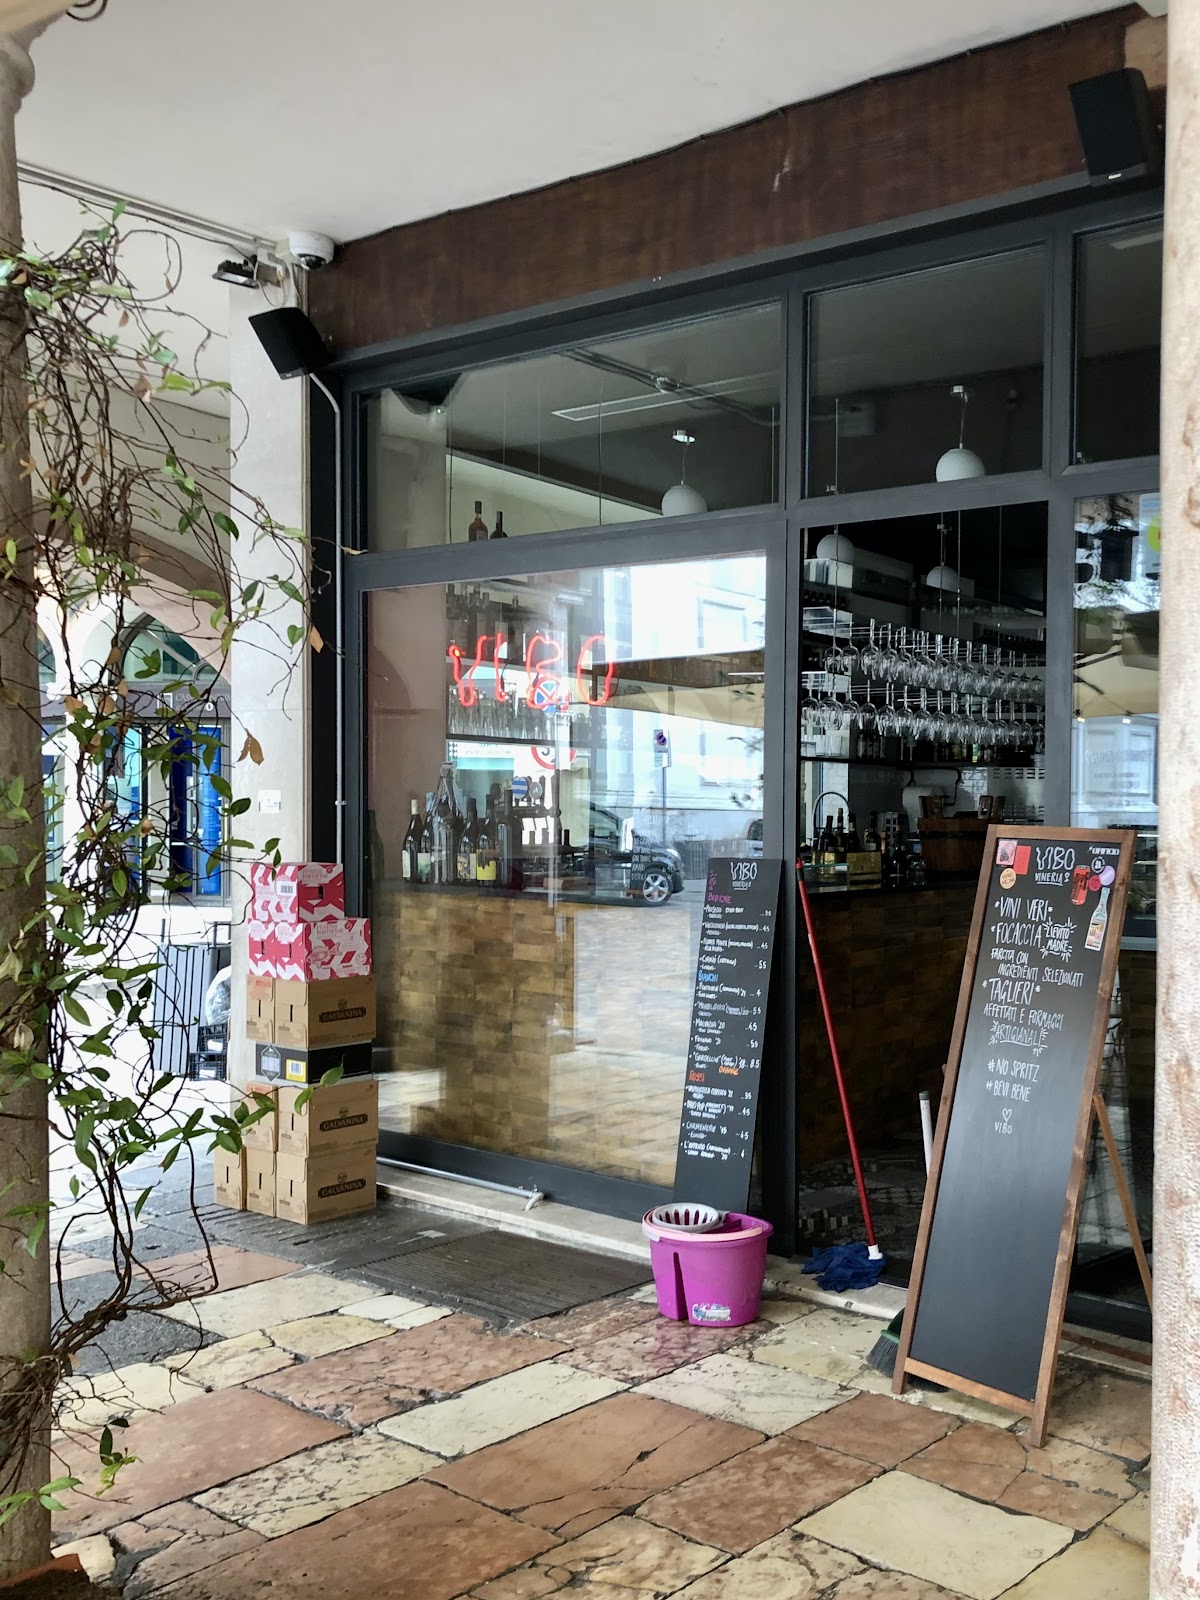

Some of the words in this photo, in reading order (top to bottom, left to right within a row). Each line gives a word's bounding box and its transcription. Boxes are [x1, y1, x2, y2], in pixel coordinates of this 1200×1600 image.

[448, 631, 614, 709] VIBO
[1036, 846, 1076, 871] VIBO
[730, 861, 758, 881] VIBO
[1034, 872, 1063, 883] VINERIA
[996, 922, 1042, 949] FOCACCIA
[1046, 926, 1070, 940] LIEVITO
[1047, 939, 1070, 952] MADRE
[990, 947, 1015, 964] FARCITA
[1016, 951, 1028, 965] CON
[997, 963, 1039, 982] INGREDIENTI
[1042, 967, 1084, 987] SELEZIONATI
[322, 1007, 364, 1021] GALVANINA
[983, 1003, 1017, 1023] AFFETTATI
[1019, 1008, 1025, 1024] E
[1028, 1009, 1065, 1031] FORMAGGI
[995, 1024, 1043, 1047] ARTIGIANALI
[688, 1069, 705, 1083] ROSSI
[1010, 1060, 1040, 1083] SPRITZ
[1011, 1082, 1032, 1102] BENE
[323, 1115, 365, 1130] GALVANINA
[994, 1121, 1013, 1135] VIBO
[321, 1179, 363, 1196] GALVANINA
